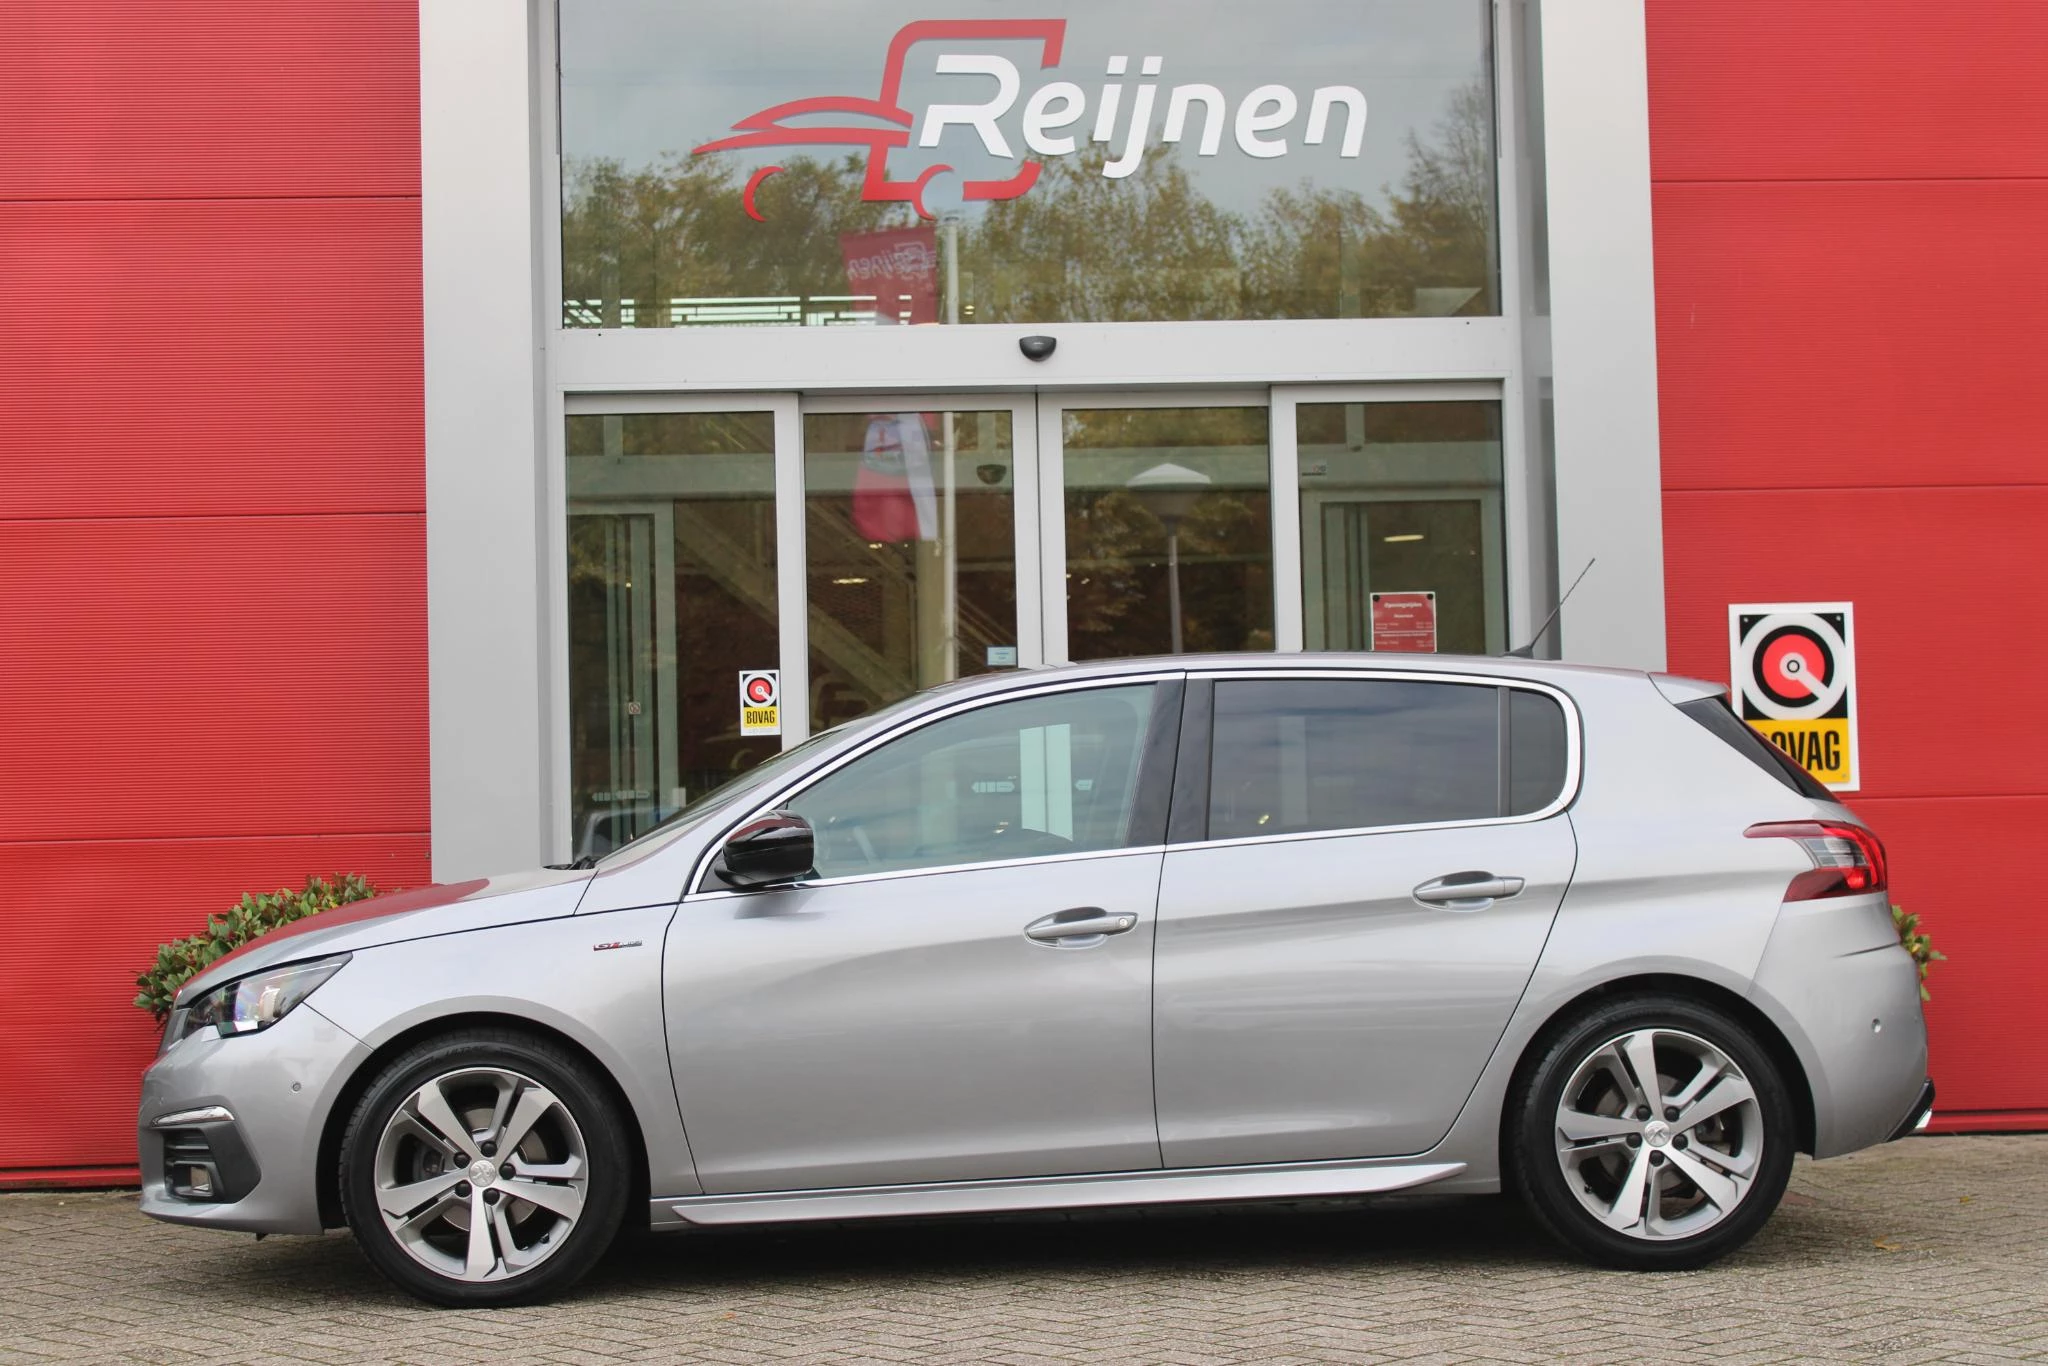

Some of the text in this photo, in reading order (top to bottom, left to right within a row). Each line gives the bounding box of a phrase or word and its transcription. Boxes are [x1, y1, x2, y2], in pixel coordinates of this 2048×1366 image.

[918, 54, 1369, 179] Reijnen
[746, 710, 775, 724] BOVAG
[1763, 730, 1840, 771] VAG
